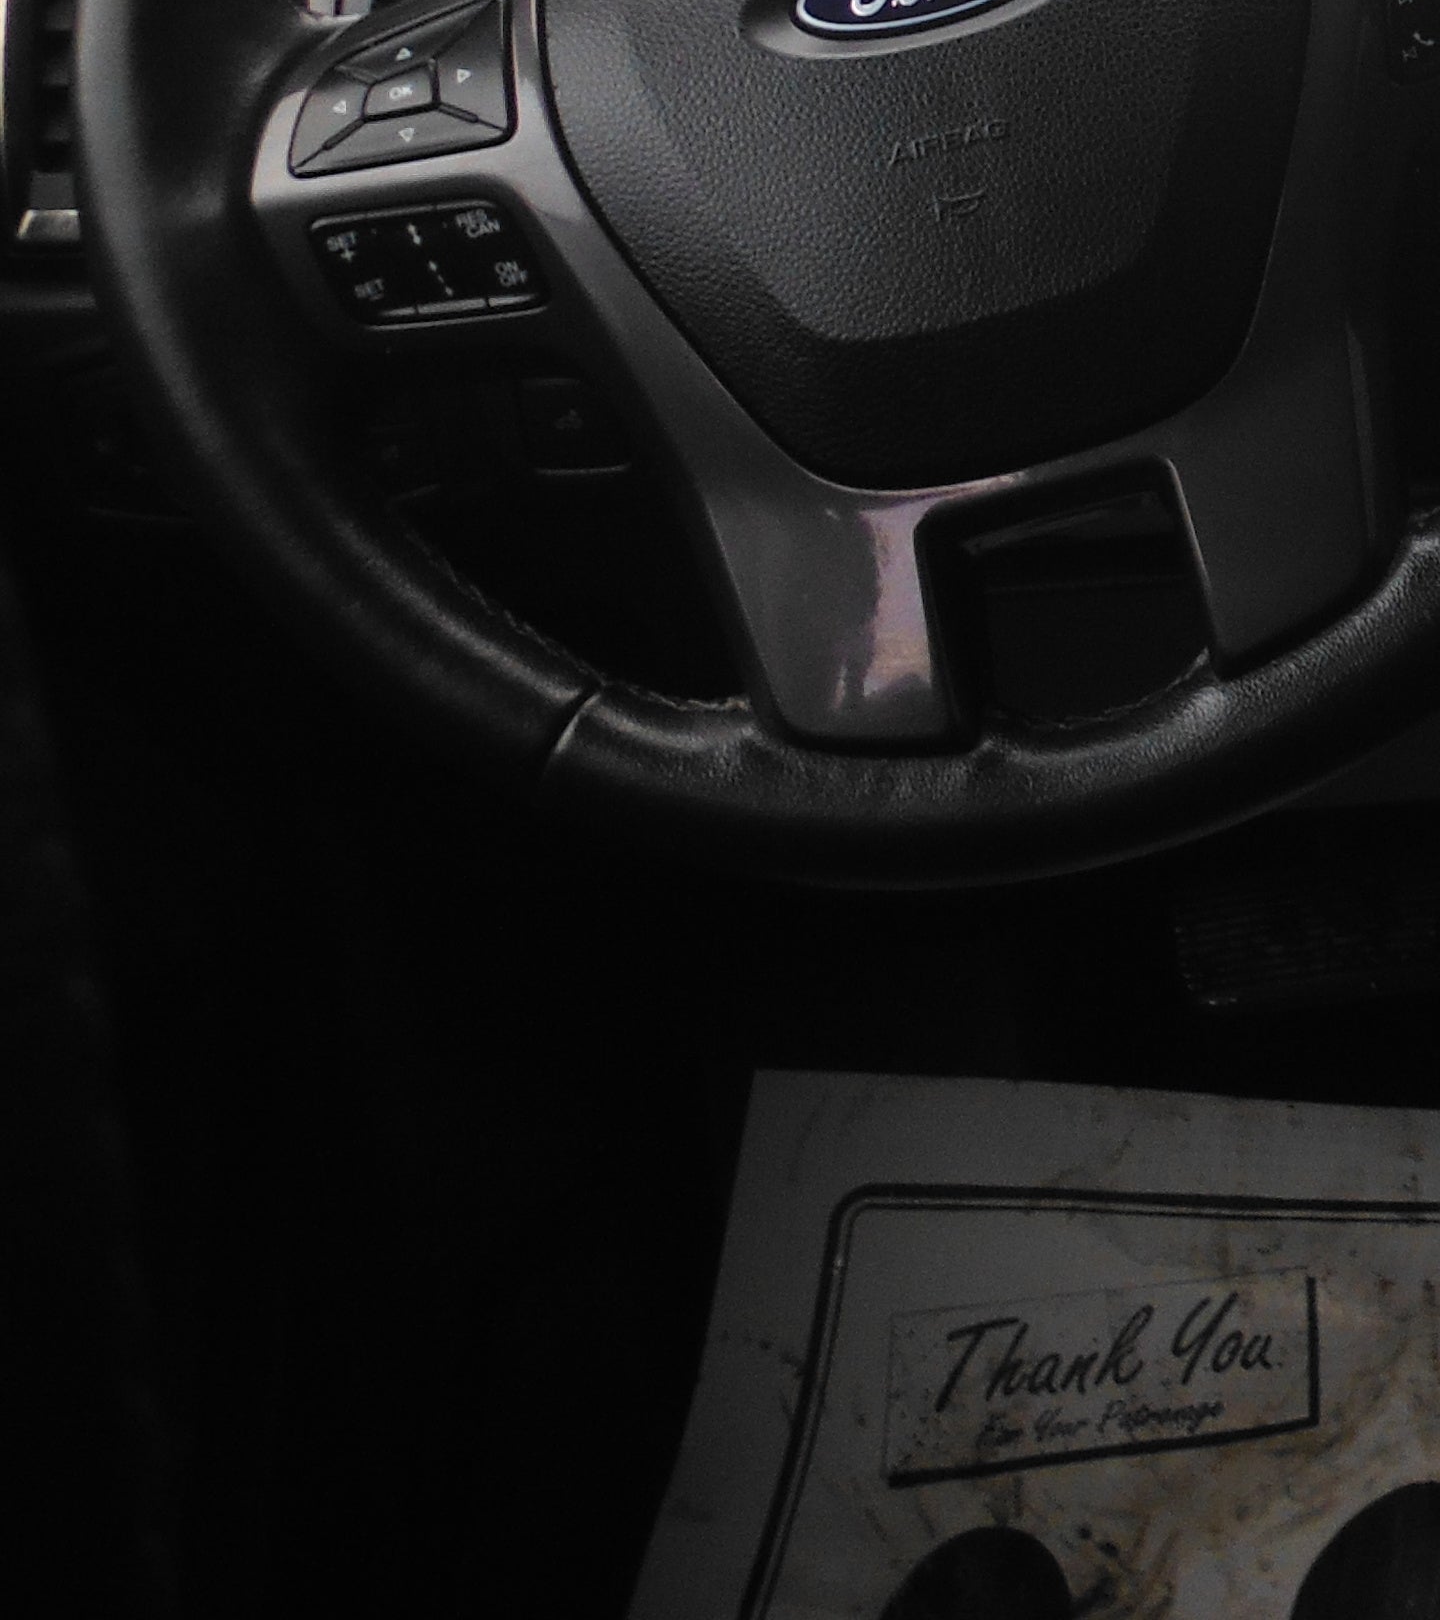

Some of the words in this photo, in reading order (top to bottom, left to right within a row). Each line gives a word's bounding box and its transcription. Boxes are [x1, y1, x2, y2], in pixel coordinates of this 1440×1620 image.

[936, 1305, 1154, 1412] Thank
[1171, 1292, 1274, 1385] You
[1034, 1405, 1088, 1442] Your
[1099, 1400, 1226, 1435] Patronage
